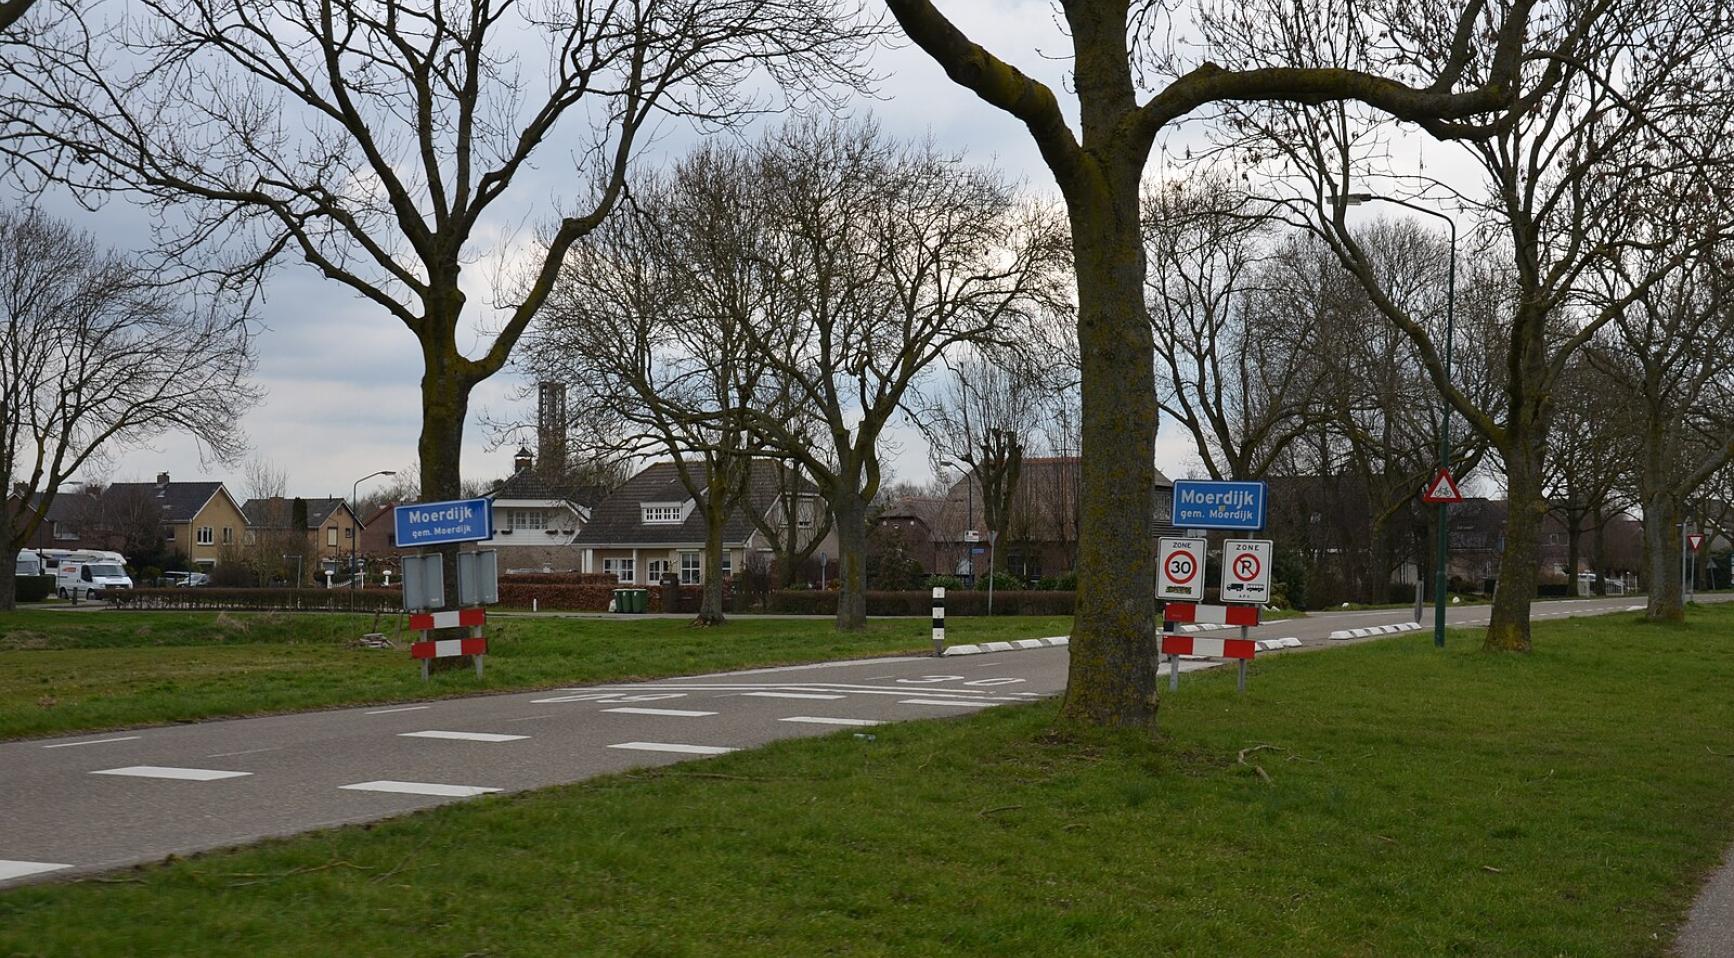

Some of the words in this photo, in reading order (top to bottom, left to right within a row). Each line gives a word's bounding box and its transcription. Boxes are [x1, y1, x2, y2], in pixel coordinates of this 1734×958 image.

[1181, 489, 1254, 509] Moerdijk
[409, 507, 472, 523] Moerdijk
[1181, 510, 1205, 519] gem.
[1210, 510, 1253, 521] Moerdijk
[412, 530, 432, 539] gem.
[434, 525, 471, 536] Moerdijk
[1171, 561, 1191, 574] 30
